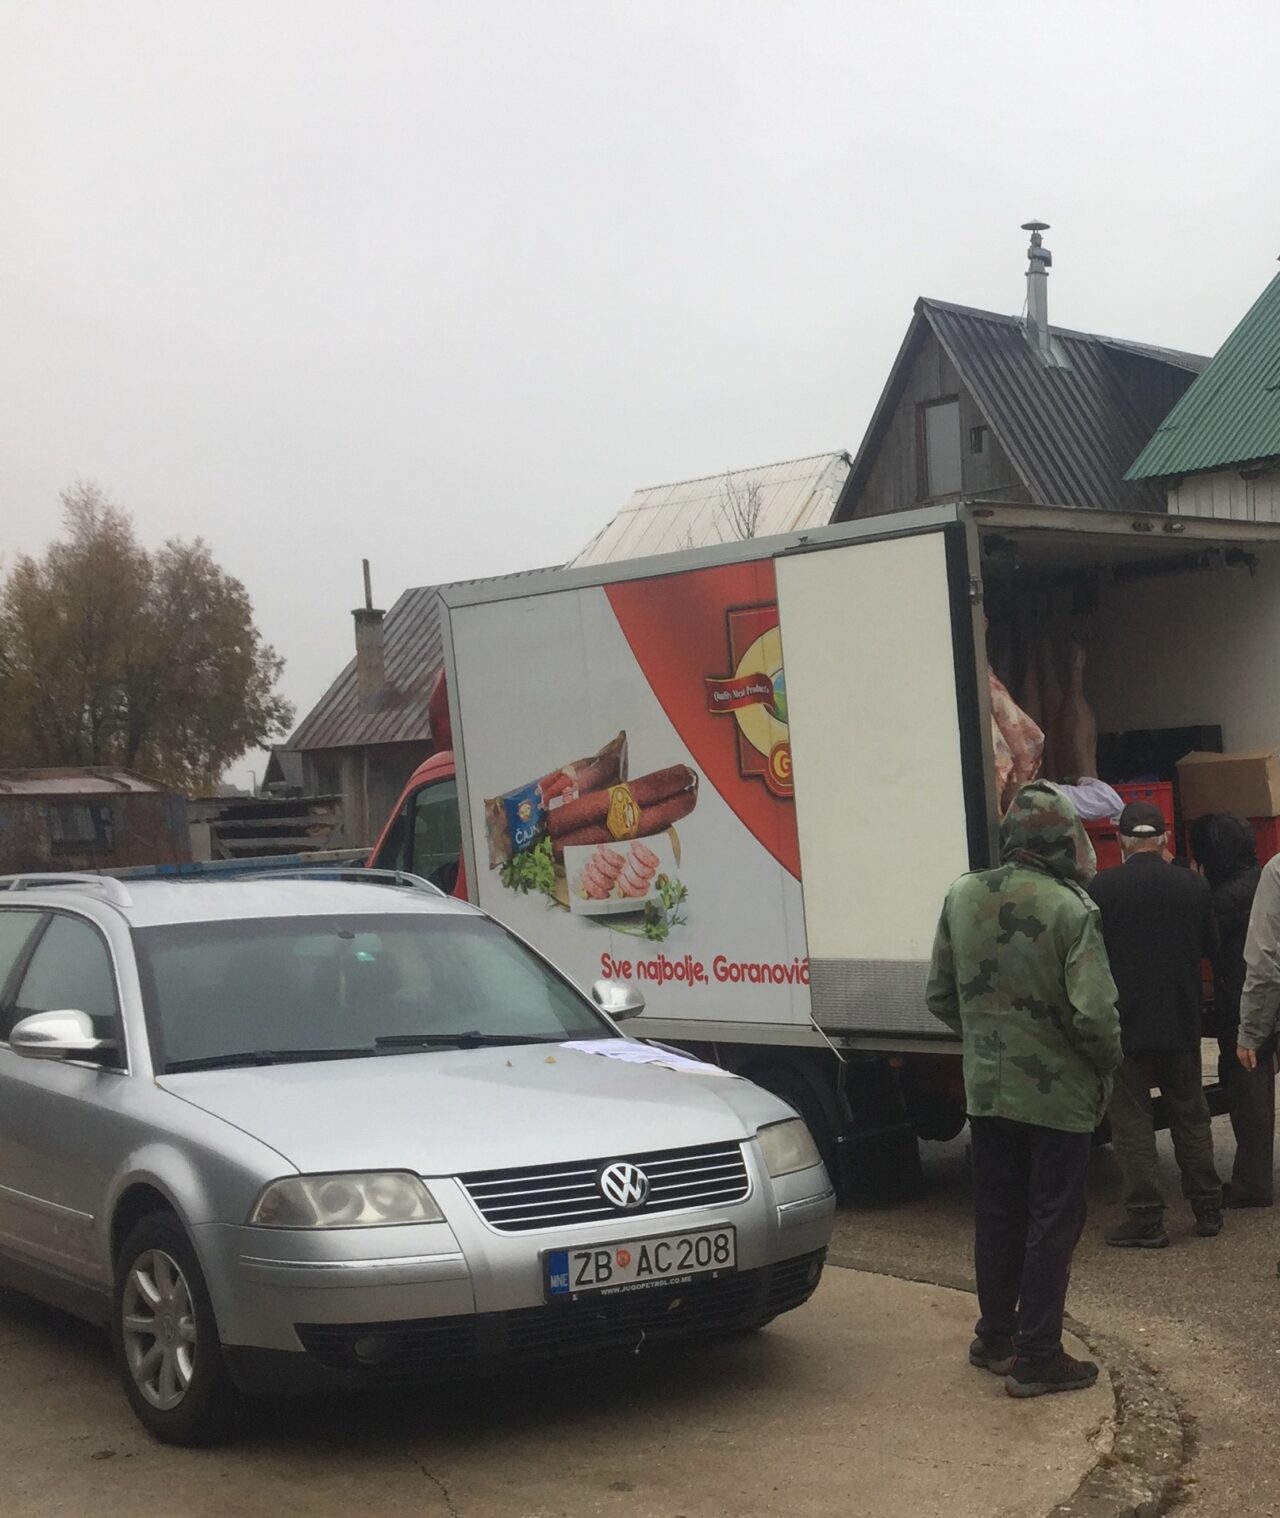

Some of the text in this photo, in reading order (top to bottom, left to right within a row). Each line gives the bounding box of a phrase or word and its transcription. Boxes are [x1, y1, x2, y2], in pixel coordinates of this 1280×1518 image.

[601, 952, 632, 980] Sve
[637, 953, 709, 987] najbolje,
[574, 1250, 613, 1286] ZB
